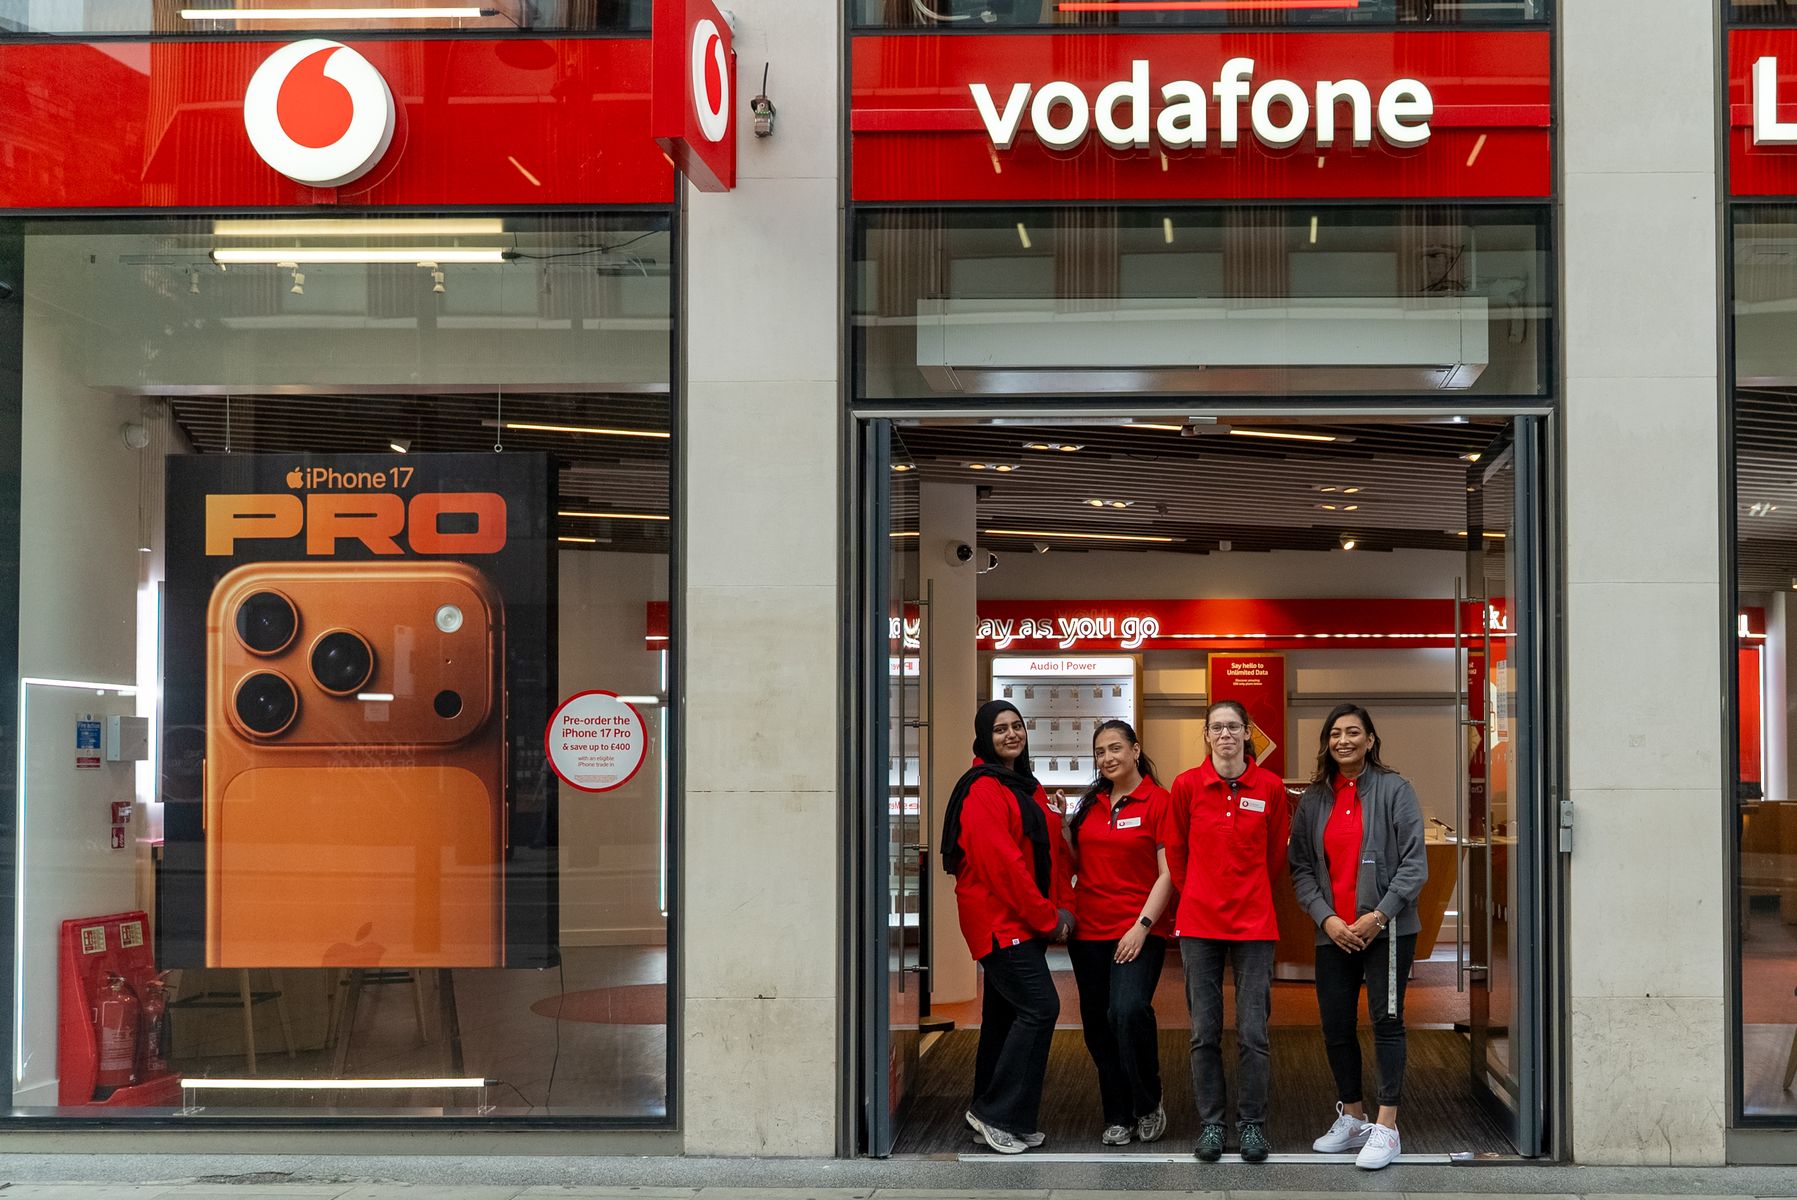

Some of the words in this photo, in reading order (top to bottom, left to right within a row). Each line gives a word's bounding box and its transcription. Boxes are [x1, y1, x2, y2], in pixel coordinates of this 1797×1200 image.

[969, 57, 1434, 148] vodafone
[307, 467, 386, 489] iPhone
[389, 467, 414, 488] 17
[206, 492, 507, 556] PRO
[1020, 617, 1053, 638] as
[1058, 617, 1115, 649] you
[1121, 617, 1159, 649] go
[1030, 662, 1059, 671] Audio
[1066, 662, 1097, 671] Power
[564, 716, 611, 725] Pre-order
[613, 716, 630, 725] the
[562, 729, 597, 737] iPhone
[600, 729, 611, 737] 17
[614, 729, 631, 737] Pro
